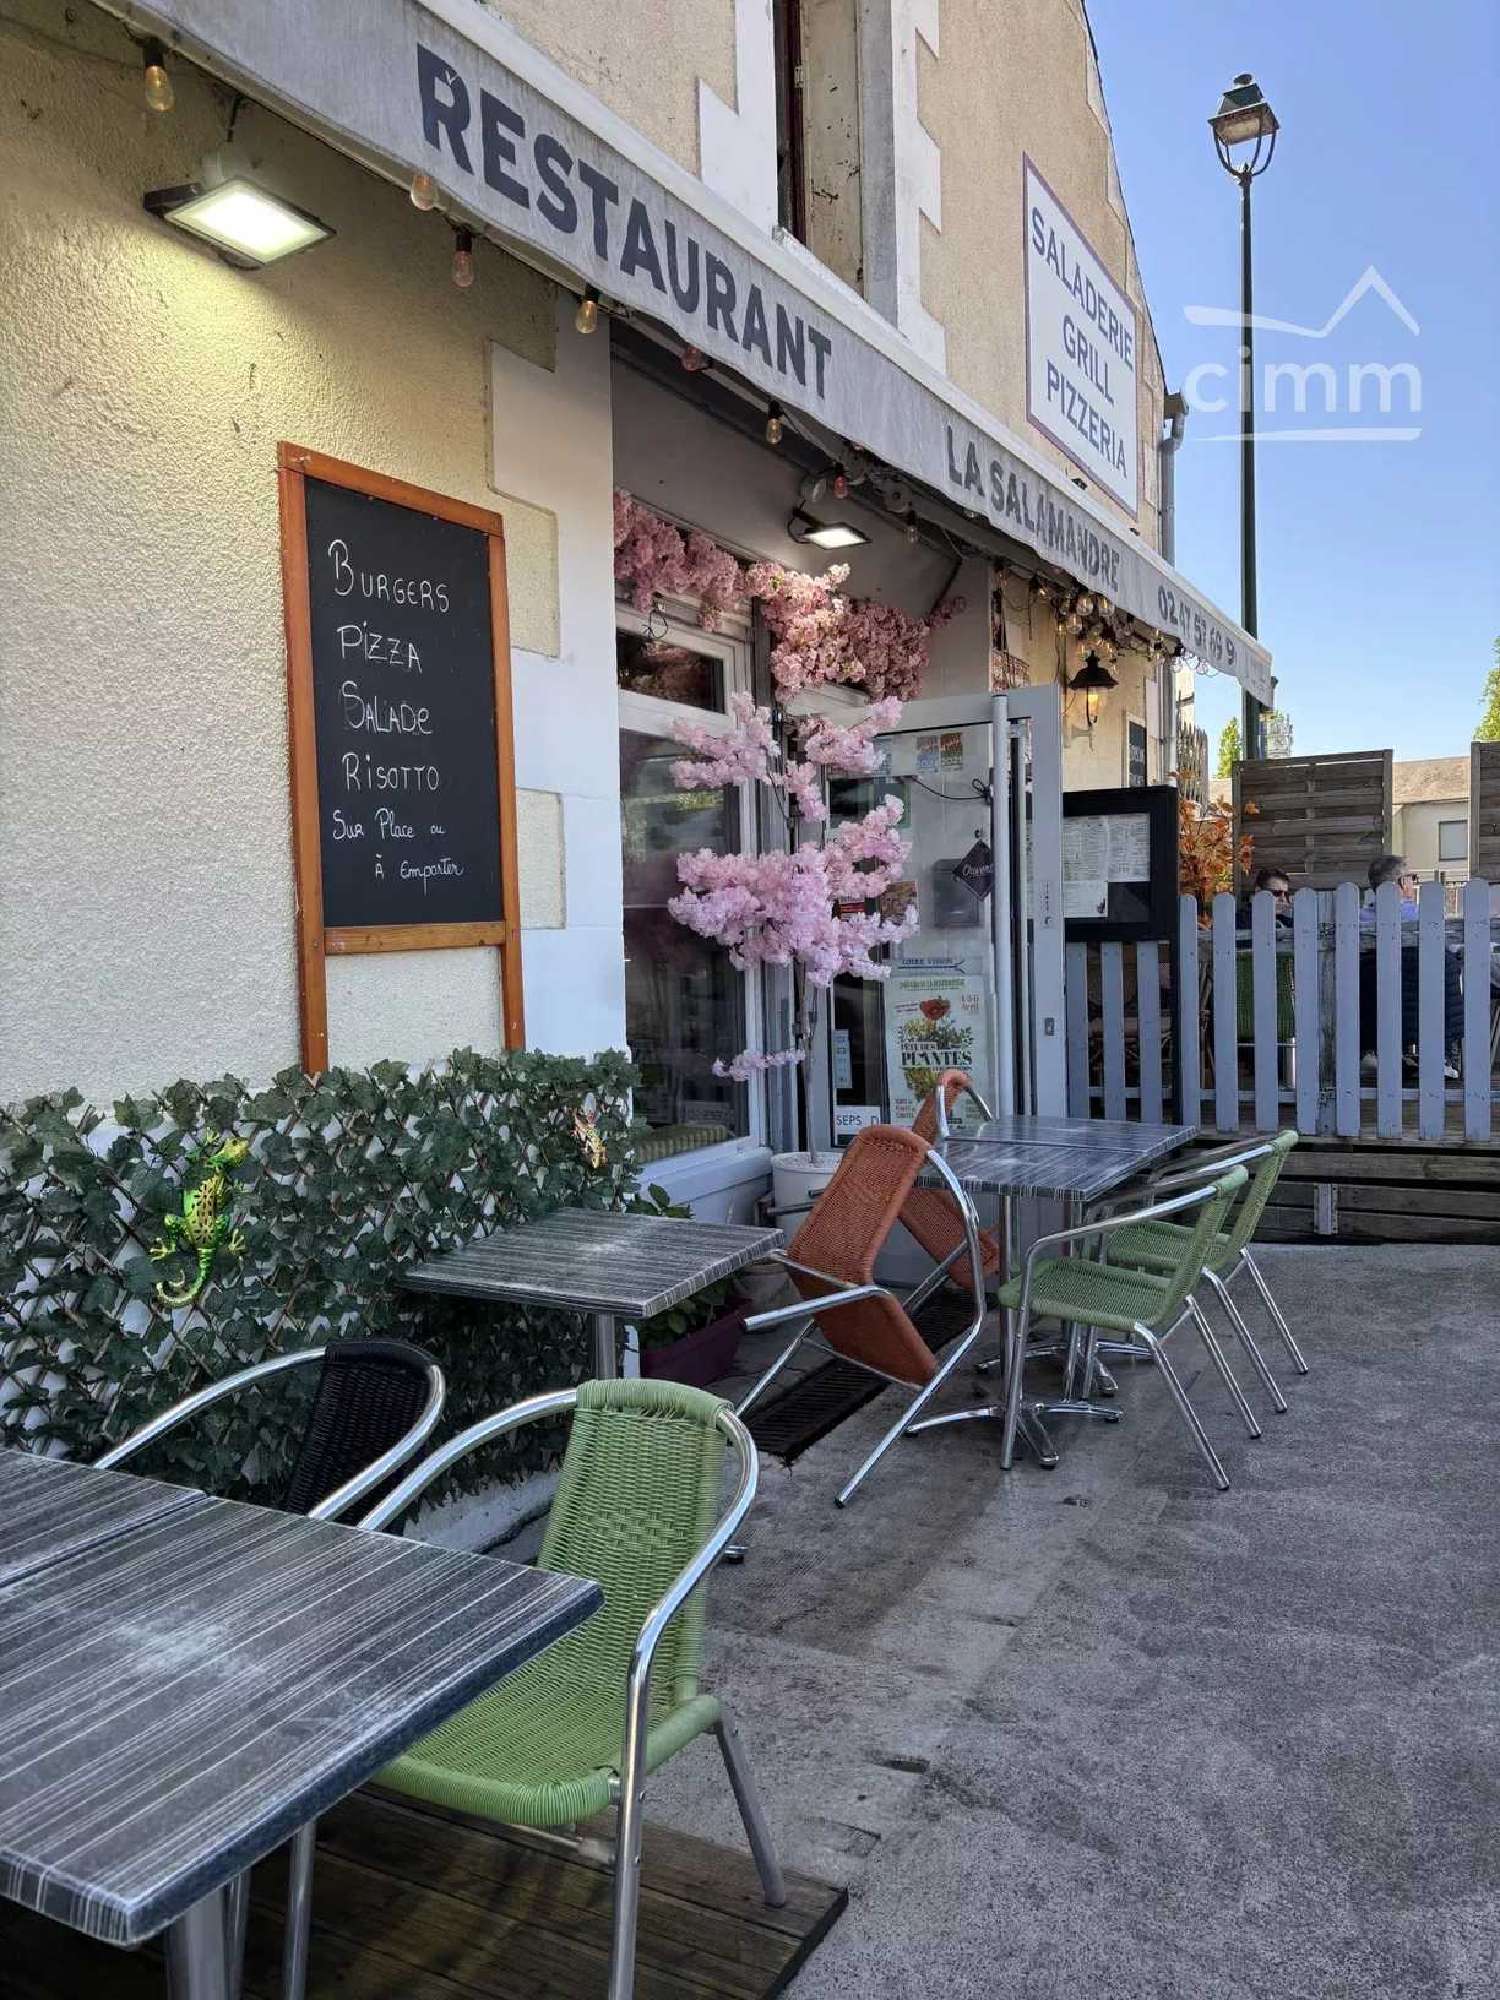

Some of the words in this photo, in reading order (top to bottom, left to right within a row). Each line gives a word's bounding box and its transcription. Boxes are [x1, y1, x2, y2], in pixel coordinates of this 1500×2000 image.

[417, 43, 832, 399] RESTAURANT
[1032, 206, 1133, 371] SALADERIE
[1063, 314, 1114, 406] GRILL
[1047, 358, 1127, 478] PIZZERIA
[946, 424, 985, 497] LA
[990, 460, 1120, 593] SALAMANDRE
[328, 539, 449, 613] BURGERS
[1158, 585, 1178, 624] 02
[375, 808, 415, 840] Place
